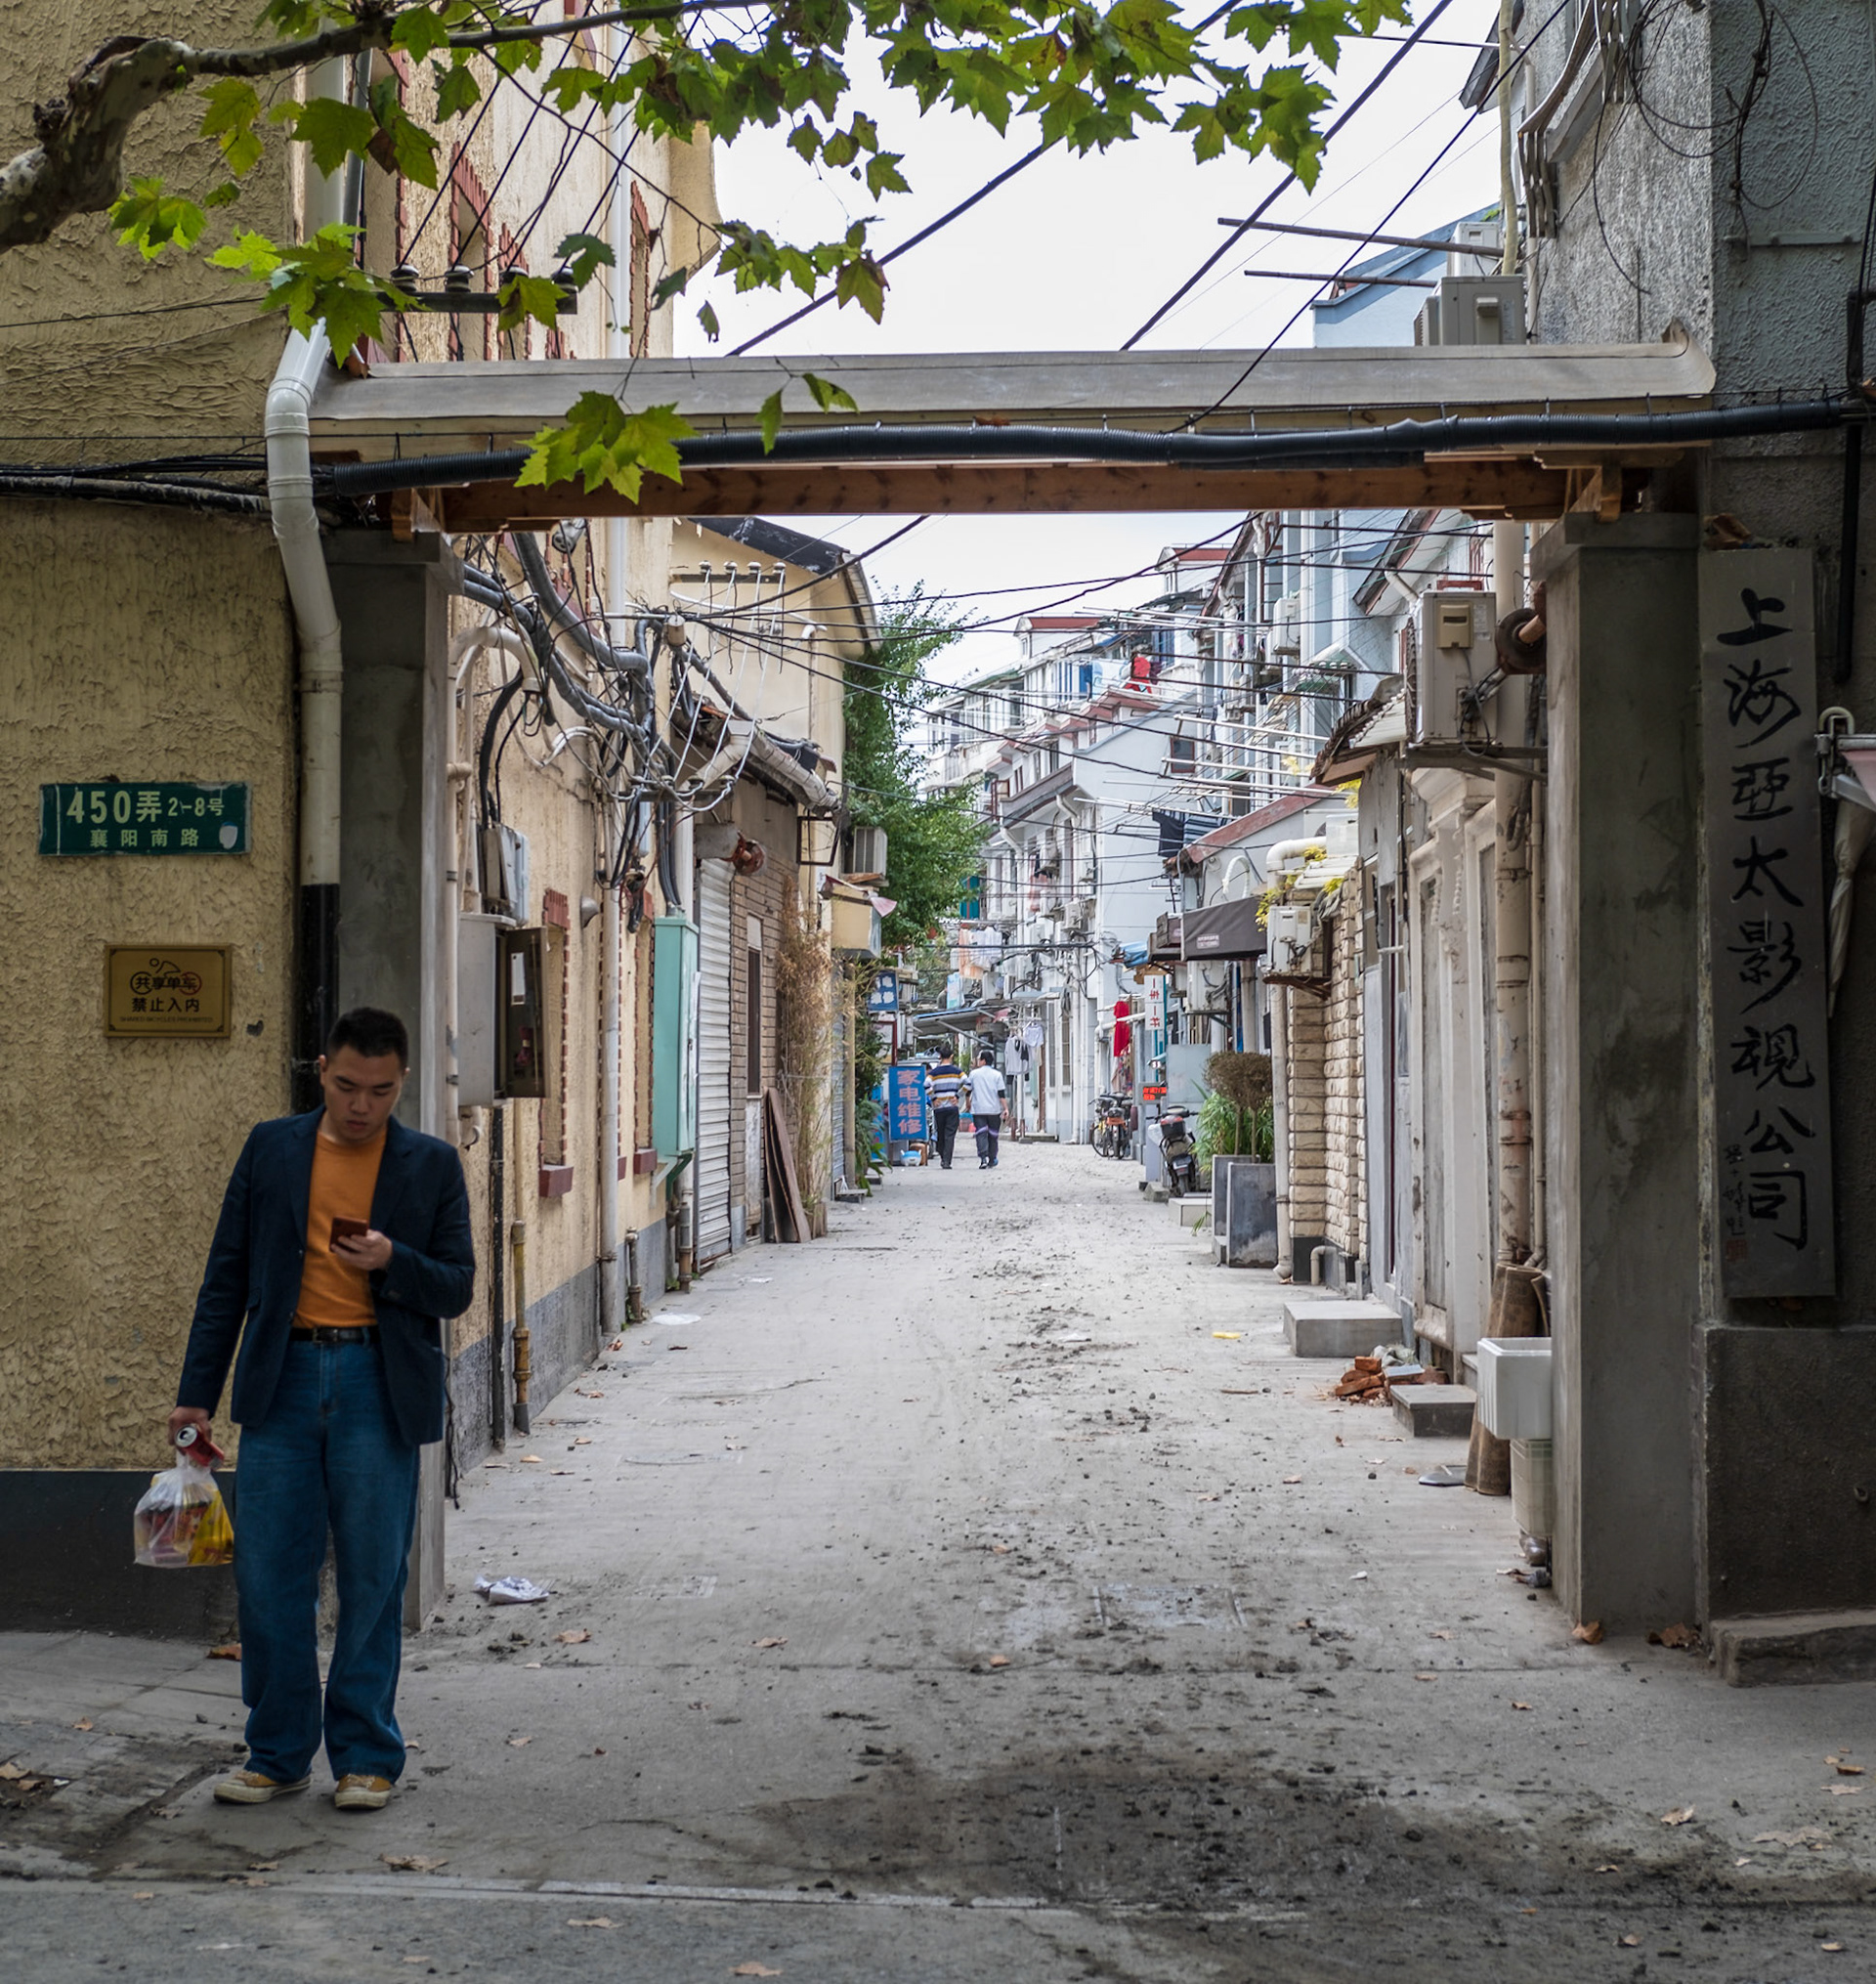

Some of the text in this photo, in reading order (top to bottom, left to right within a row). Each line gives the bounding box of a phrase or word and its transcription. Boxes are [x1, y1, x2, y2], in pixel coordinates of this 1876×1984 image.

[90, 828, 199, 847] 襄阳南路
[135, 975, 197, 990] 共享单车
[132, 997, 199, 1013] 禁止入内
[897, 1070, 922, 1135] 家电维修
